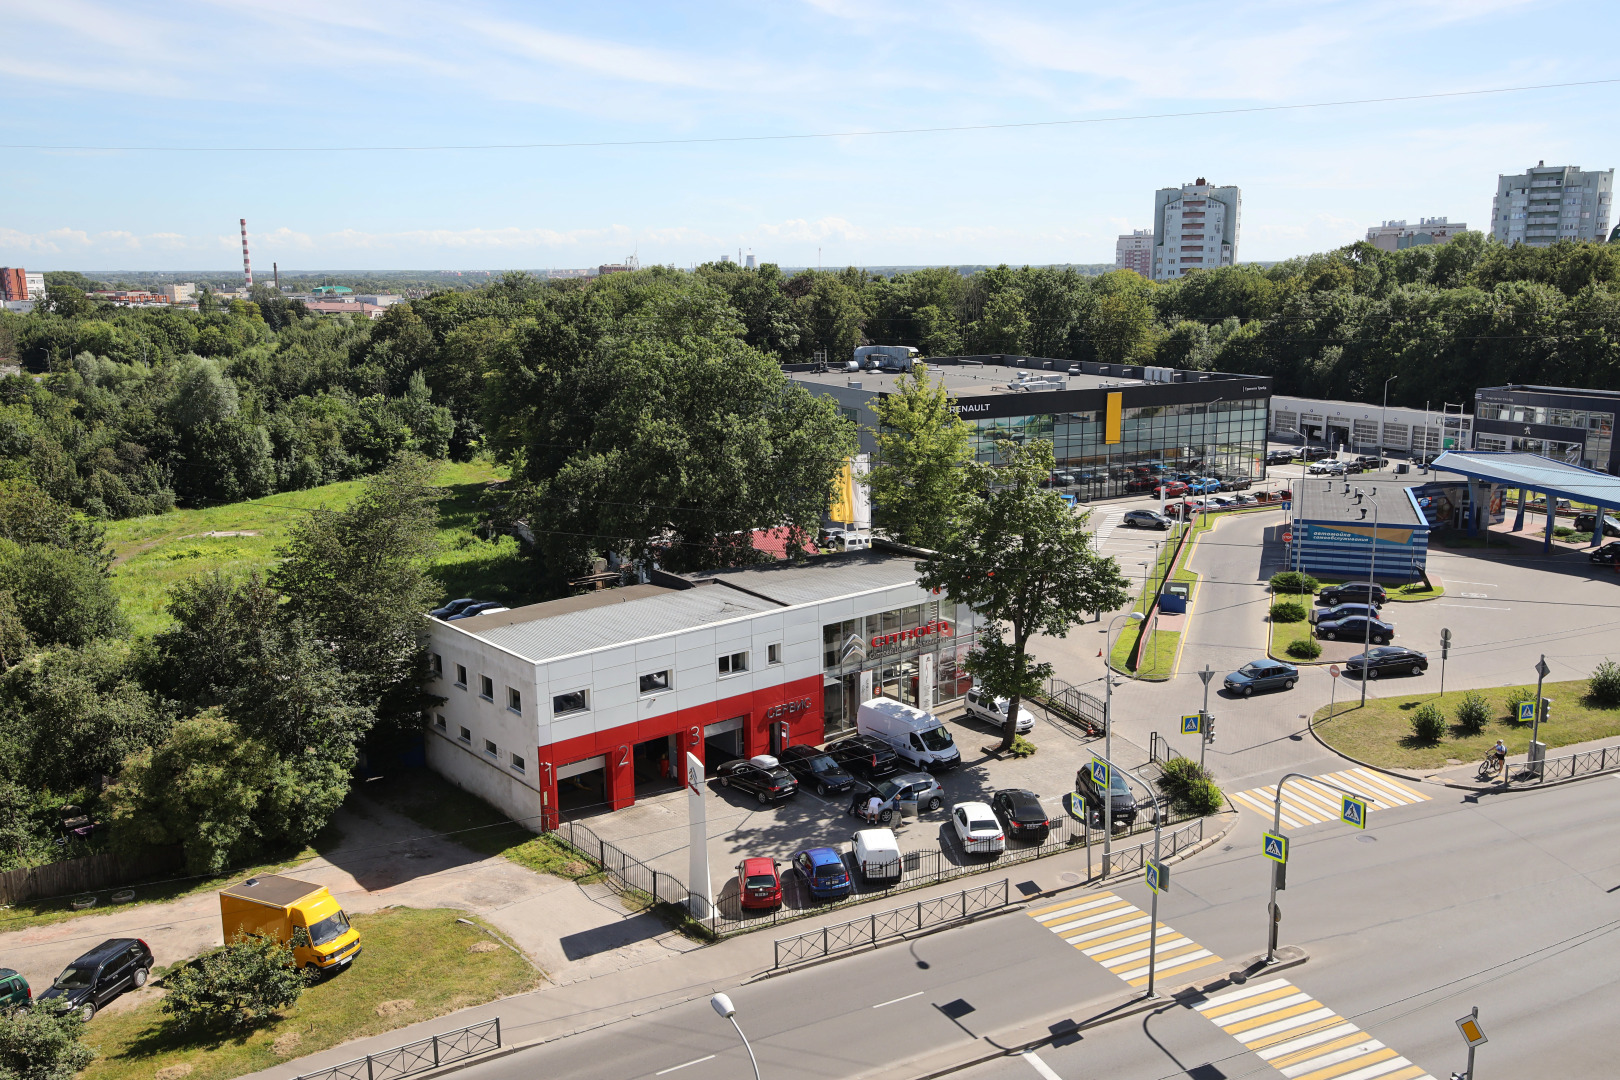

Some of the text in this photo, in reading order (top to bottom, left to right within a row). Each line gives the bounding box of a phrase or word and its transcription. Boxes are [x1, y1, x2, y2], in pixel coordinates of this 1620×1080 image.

[949, 403, 991, 414] RENAULT
[767, 697, 812, 719] СЕРВИС
[690, 726, 701, 746] 3
[618, 745, 629, 767] 2
